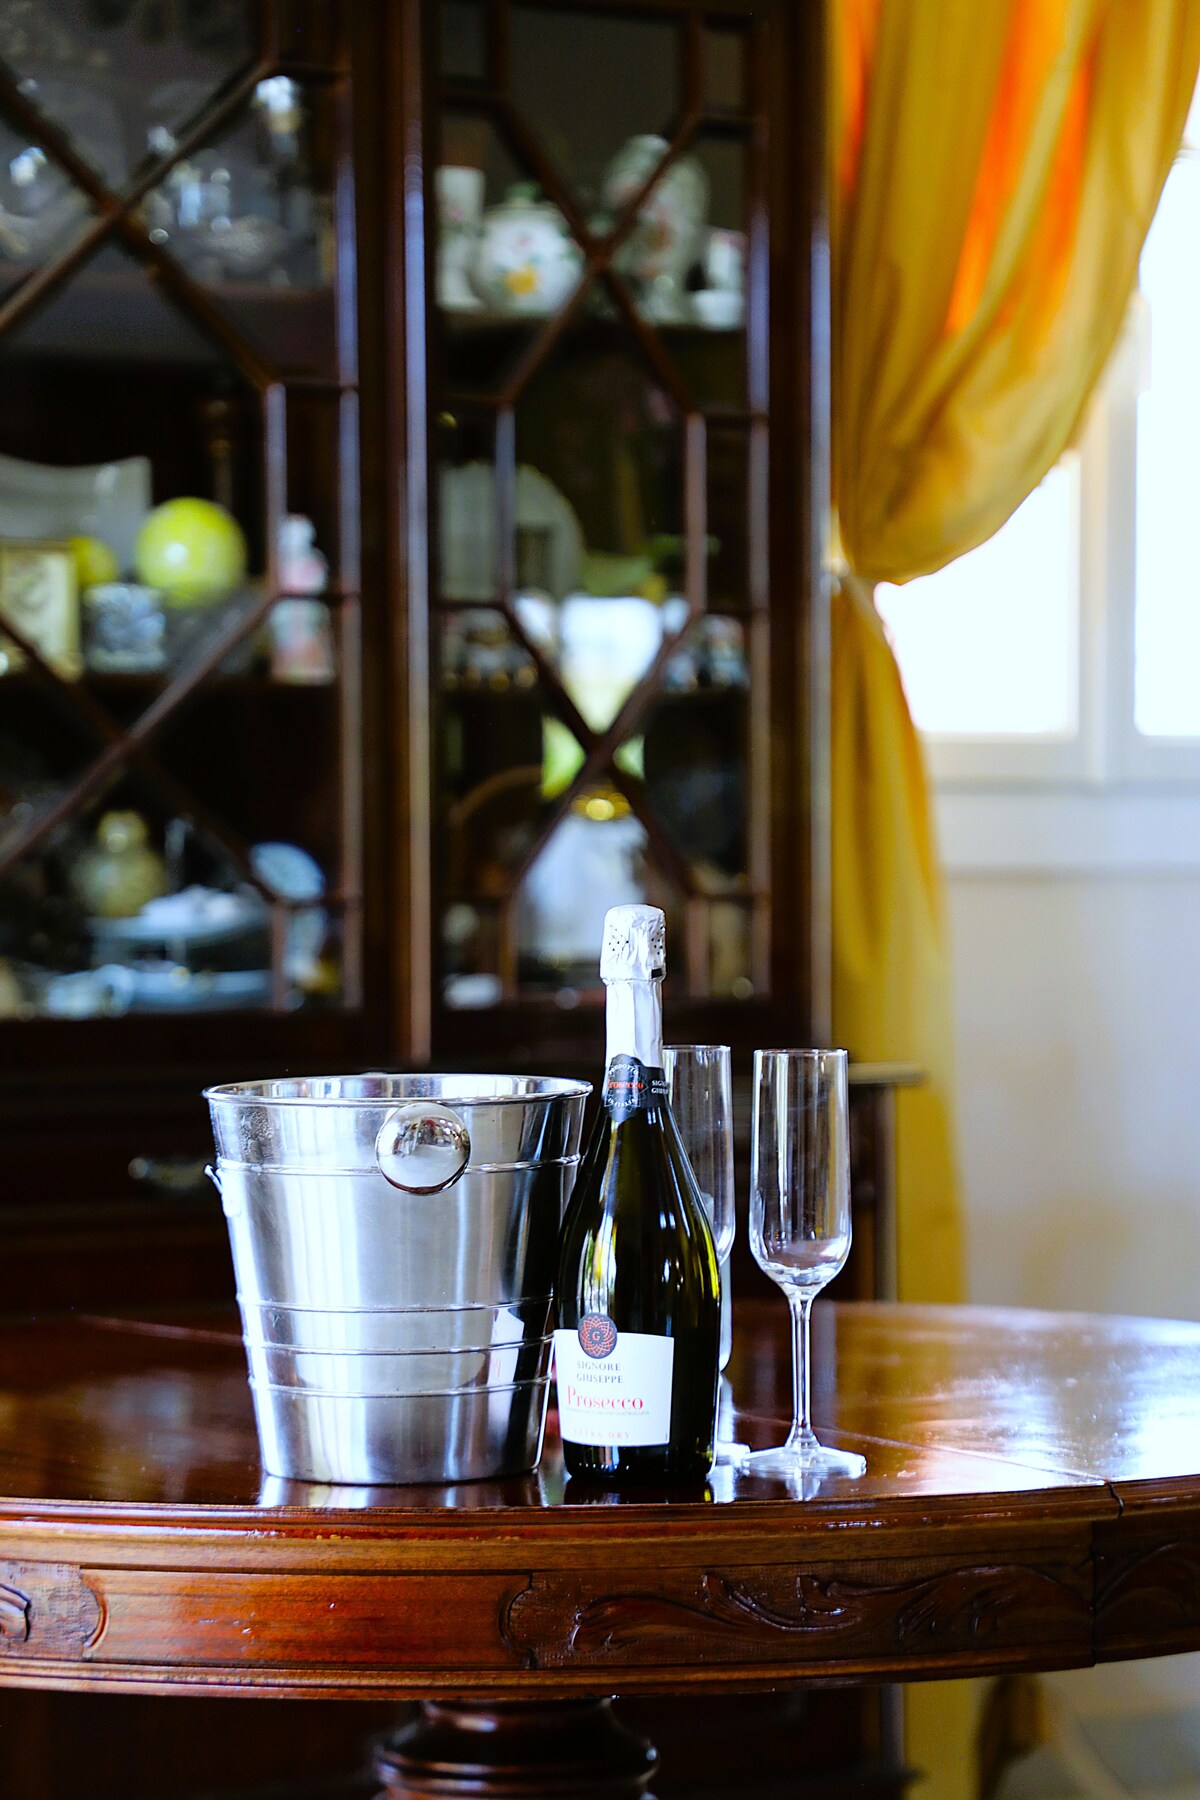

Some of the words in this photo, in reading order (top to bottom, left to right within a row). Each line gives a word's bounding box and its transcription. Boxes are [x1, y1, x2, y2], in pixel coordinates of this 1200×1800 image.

[592, 1331, 601, 1341] G
[577, 1361, 621, 1371] SIGNORE
[576, 1373, 624, 1384] GIUSEPPE
[567, 1384, 644, 1410] Prosecco
[608, 1431, 631, 1439] DRY
